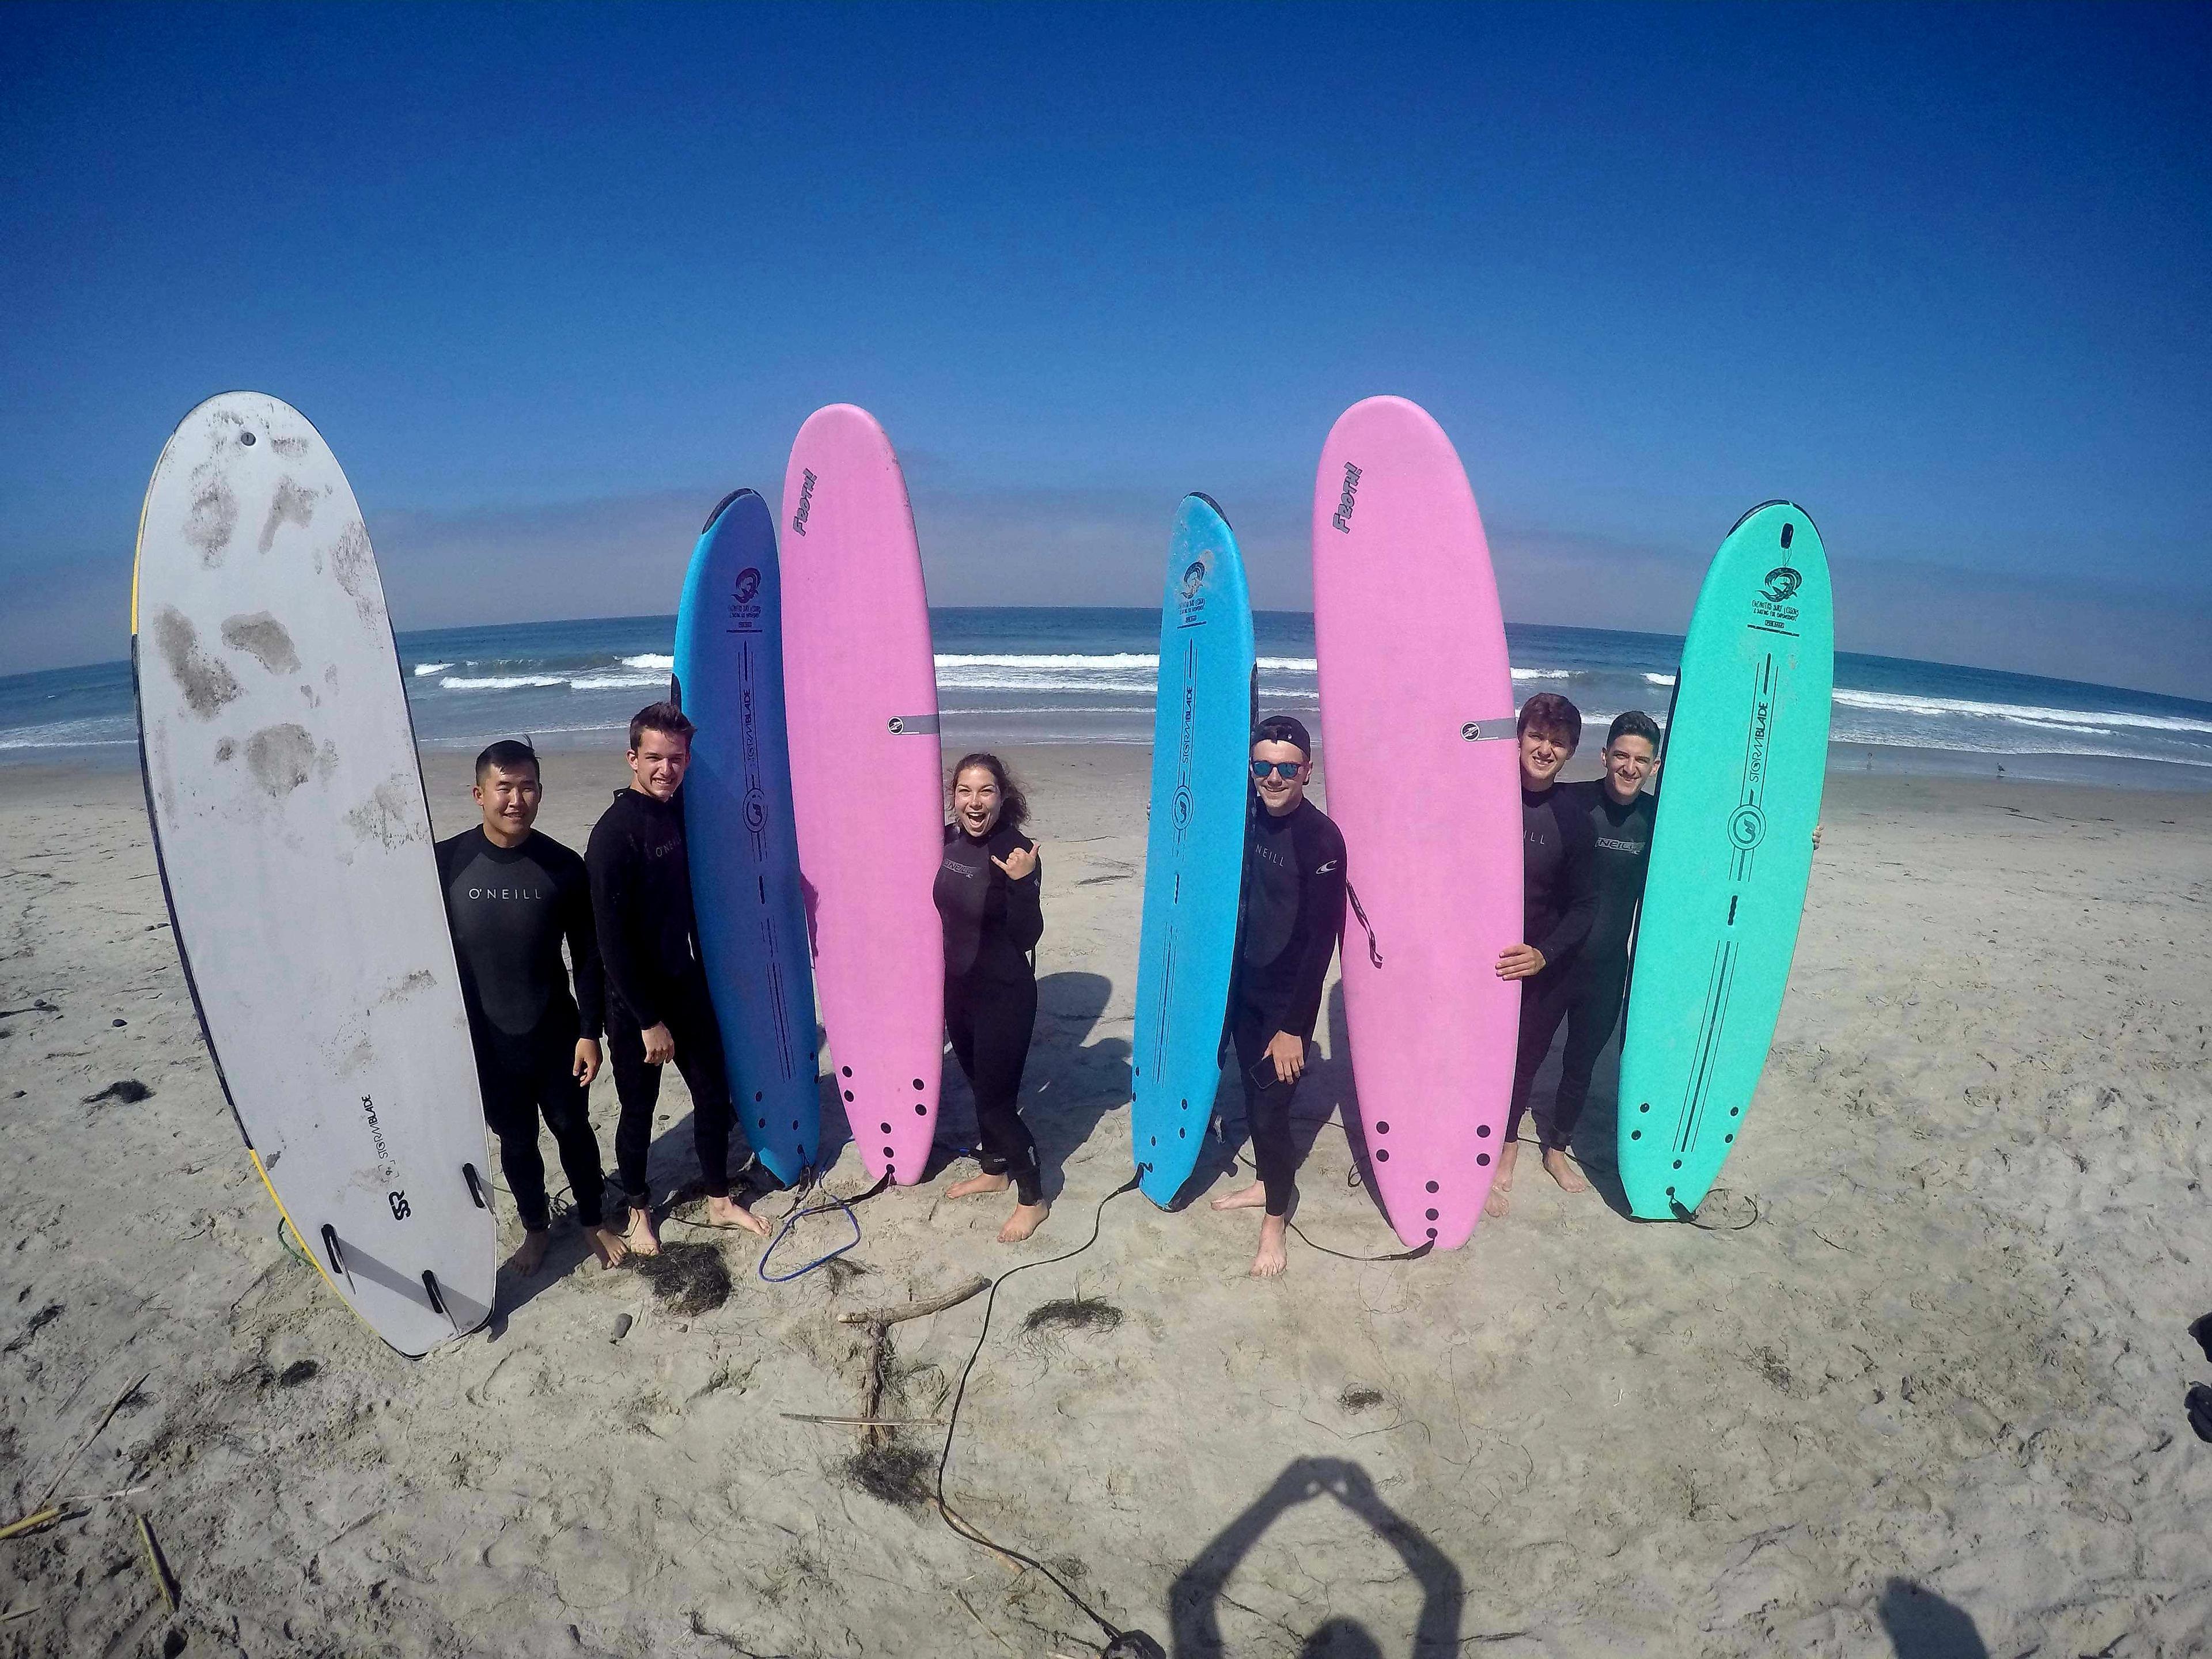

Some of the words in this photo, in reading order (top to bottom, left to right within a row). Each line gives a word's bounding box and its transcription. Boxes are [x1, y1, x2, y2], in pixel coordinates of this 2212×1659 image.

[792, 468, 817, 537] FROTH!
[1332, 461, 1363, 534] FROTH!
[743, 688, 756, 767] ORMBLADE
[1183, 685, 1193, 764] STORMBLADE
[1749, 701, 1768, 783] STORMBLADE
[468, 888, 542, 900] O'NEILL
[361, 1094, 388, 1160] STORMBLADE
[388, 1190, 411, 1221] SSR
